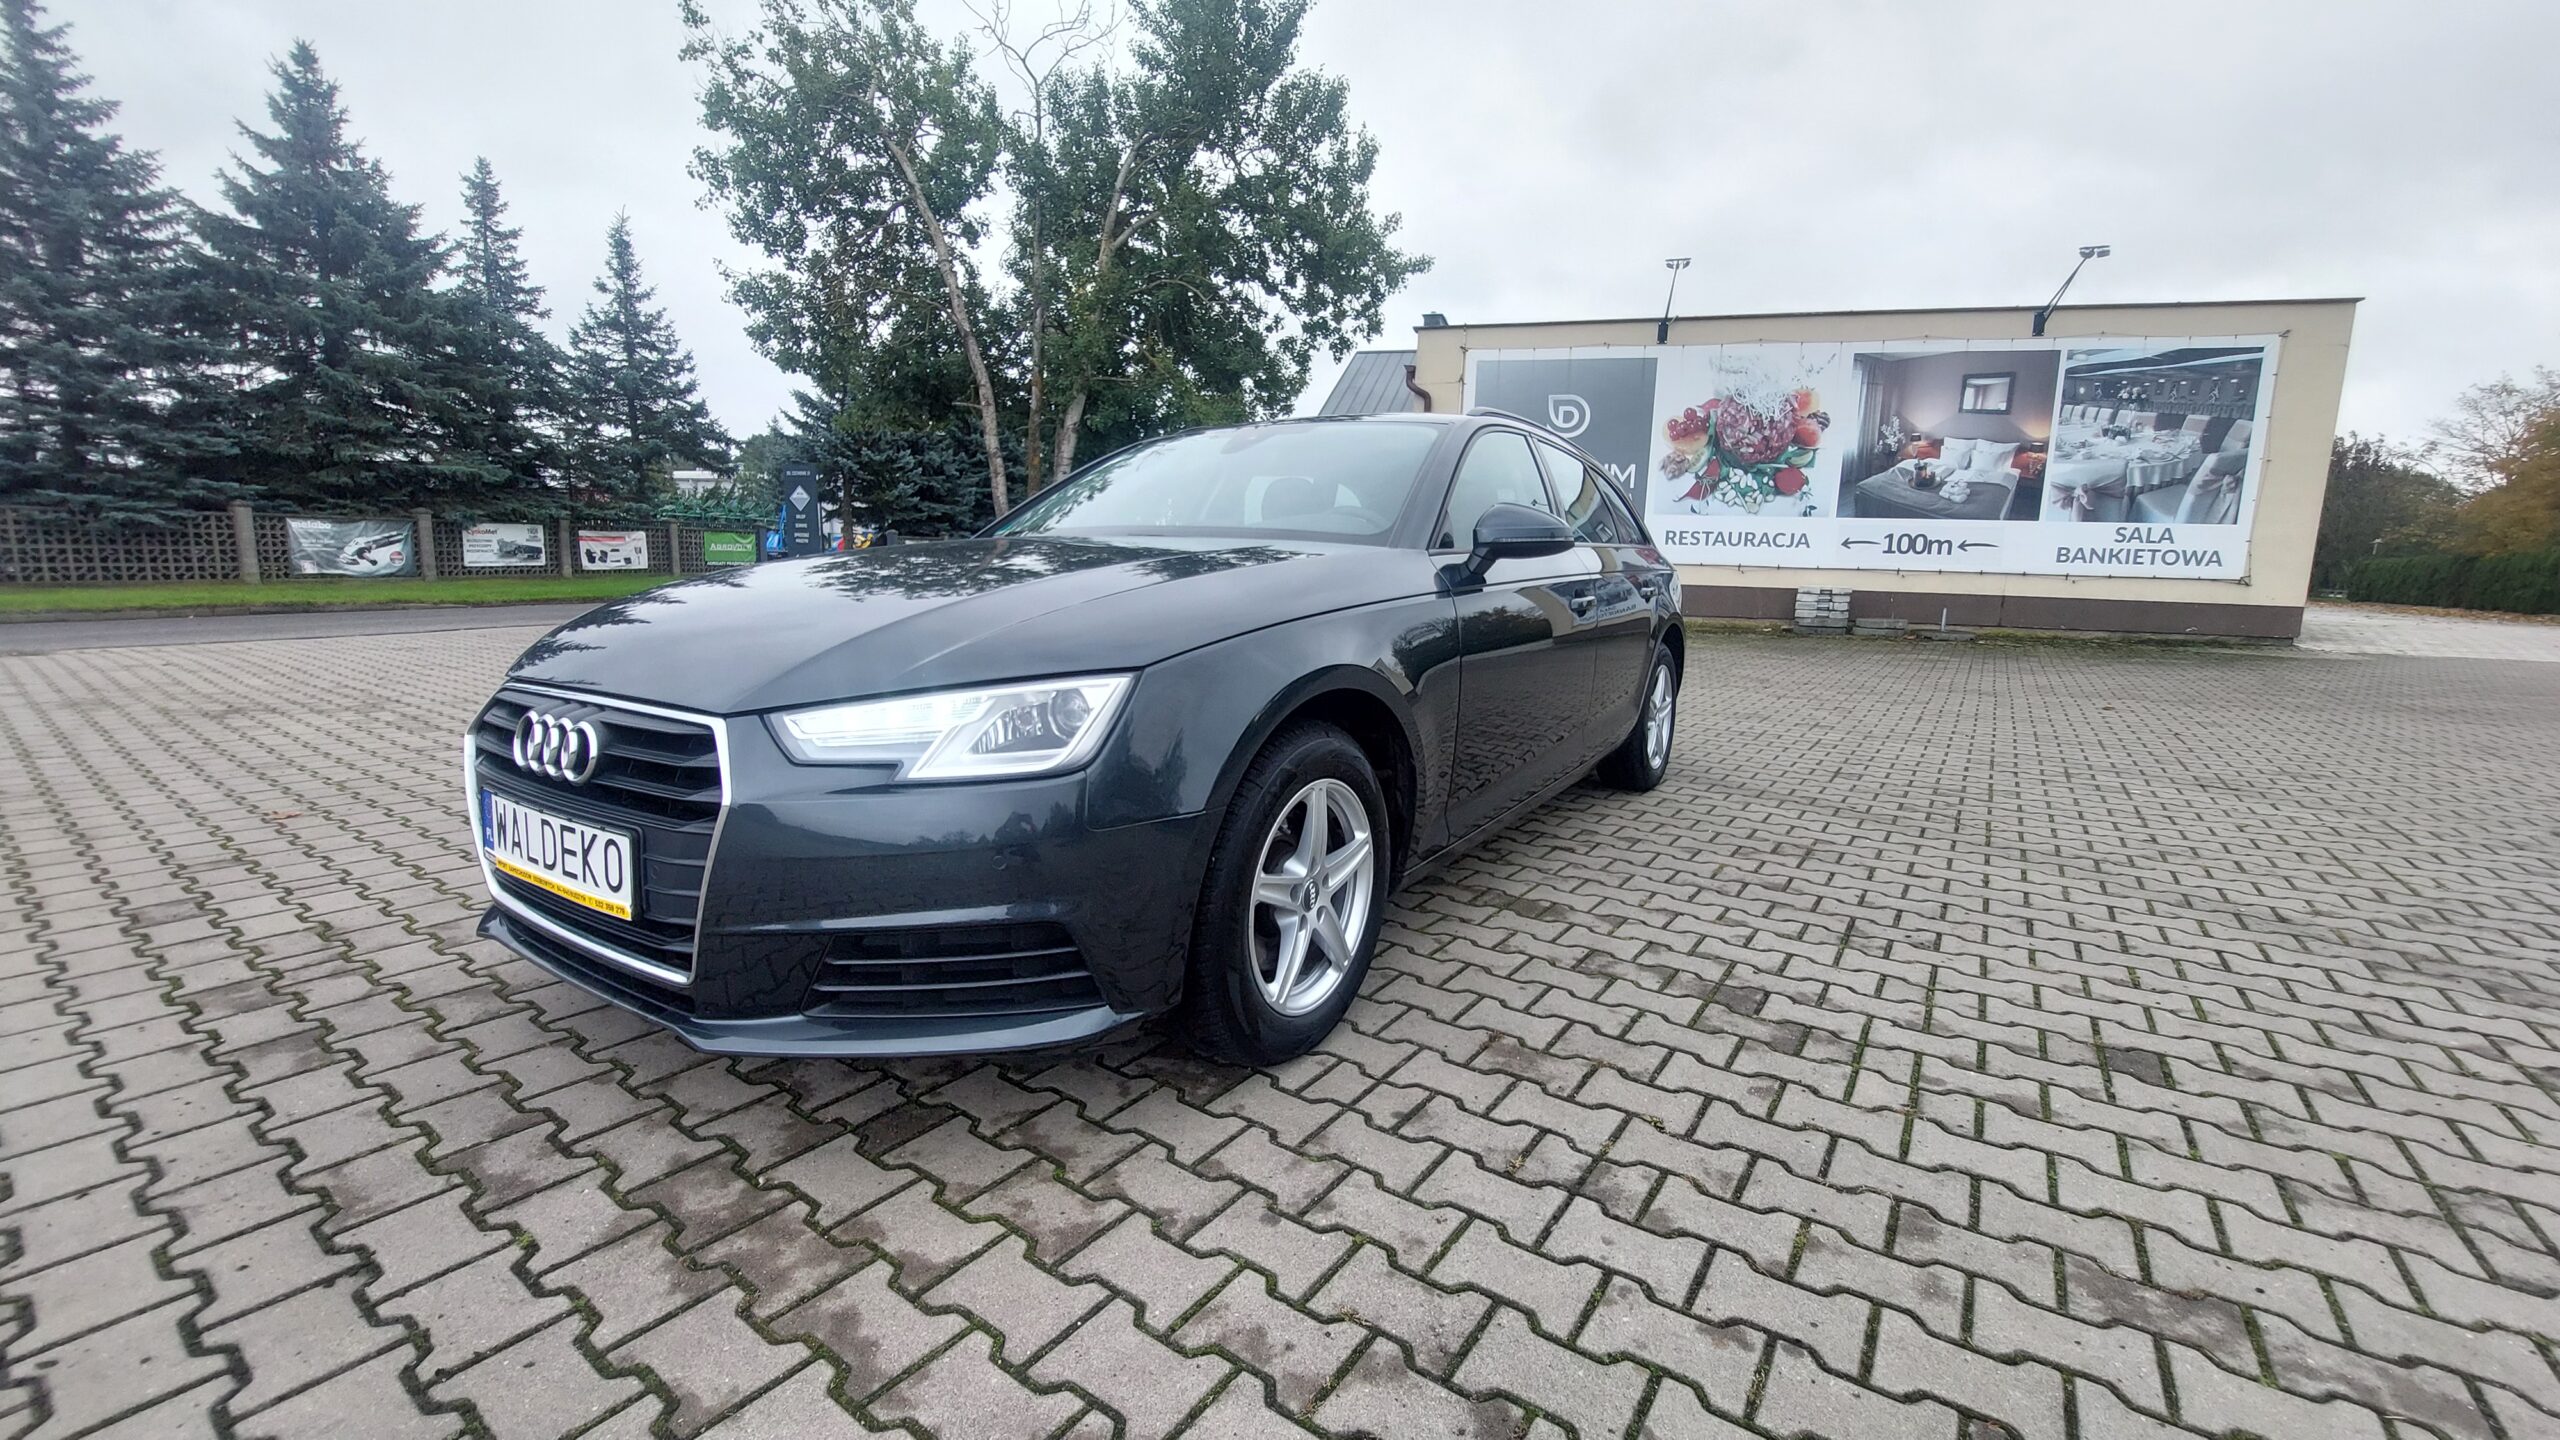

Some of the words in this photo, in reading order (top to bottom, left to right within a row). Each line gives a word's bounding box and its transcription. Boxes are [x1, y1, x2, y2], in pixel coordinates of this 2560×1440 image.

[1664, 530, 1811, 549] RESTAURACJA
[1882, 532, 1953, 556] 100m
[2113, 526, 2175, 544] SALA
[2055, 546, 2223, 568] BANKIETOWA
[486, 827, 494, 841] PL
[495, 799, 623, 893] WALDEKO
